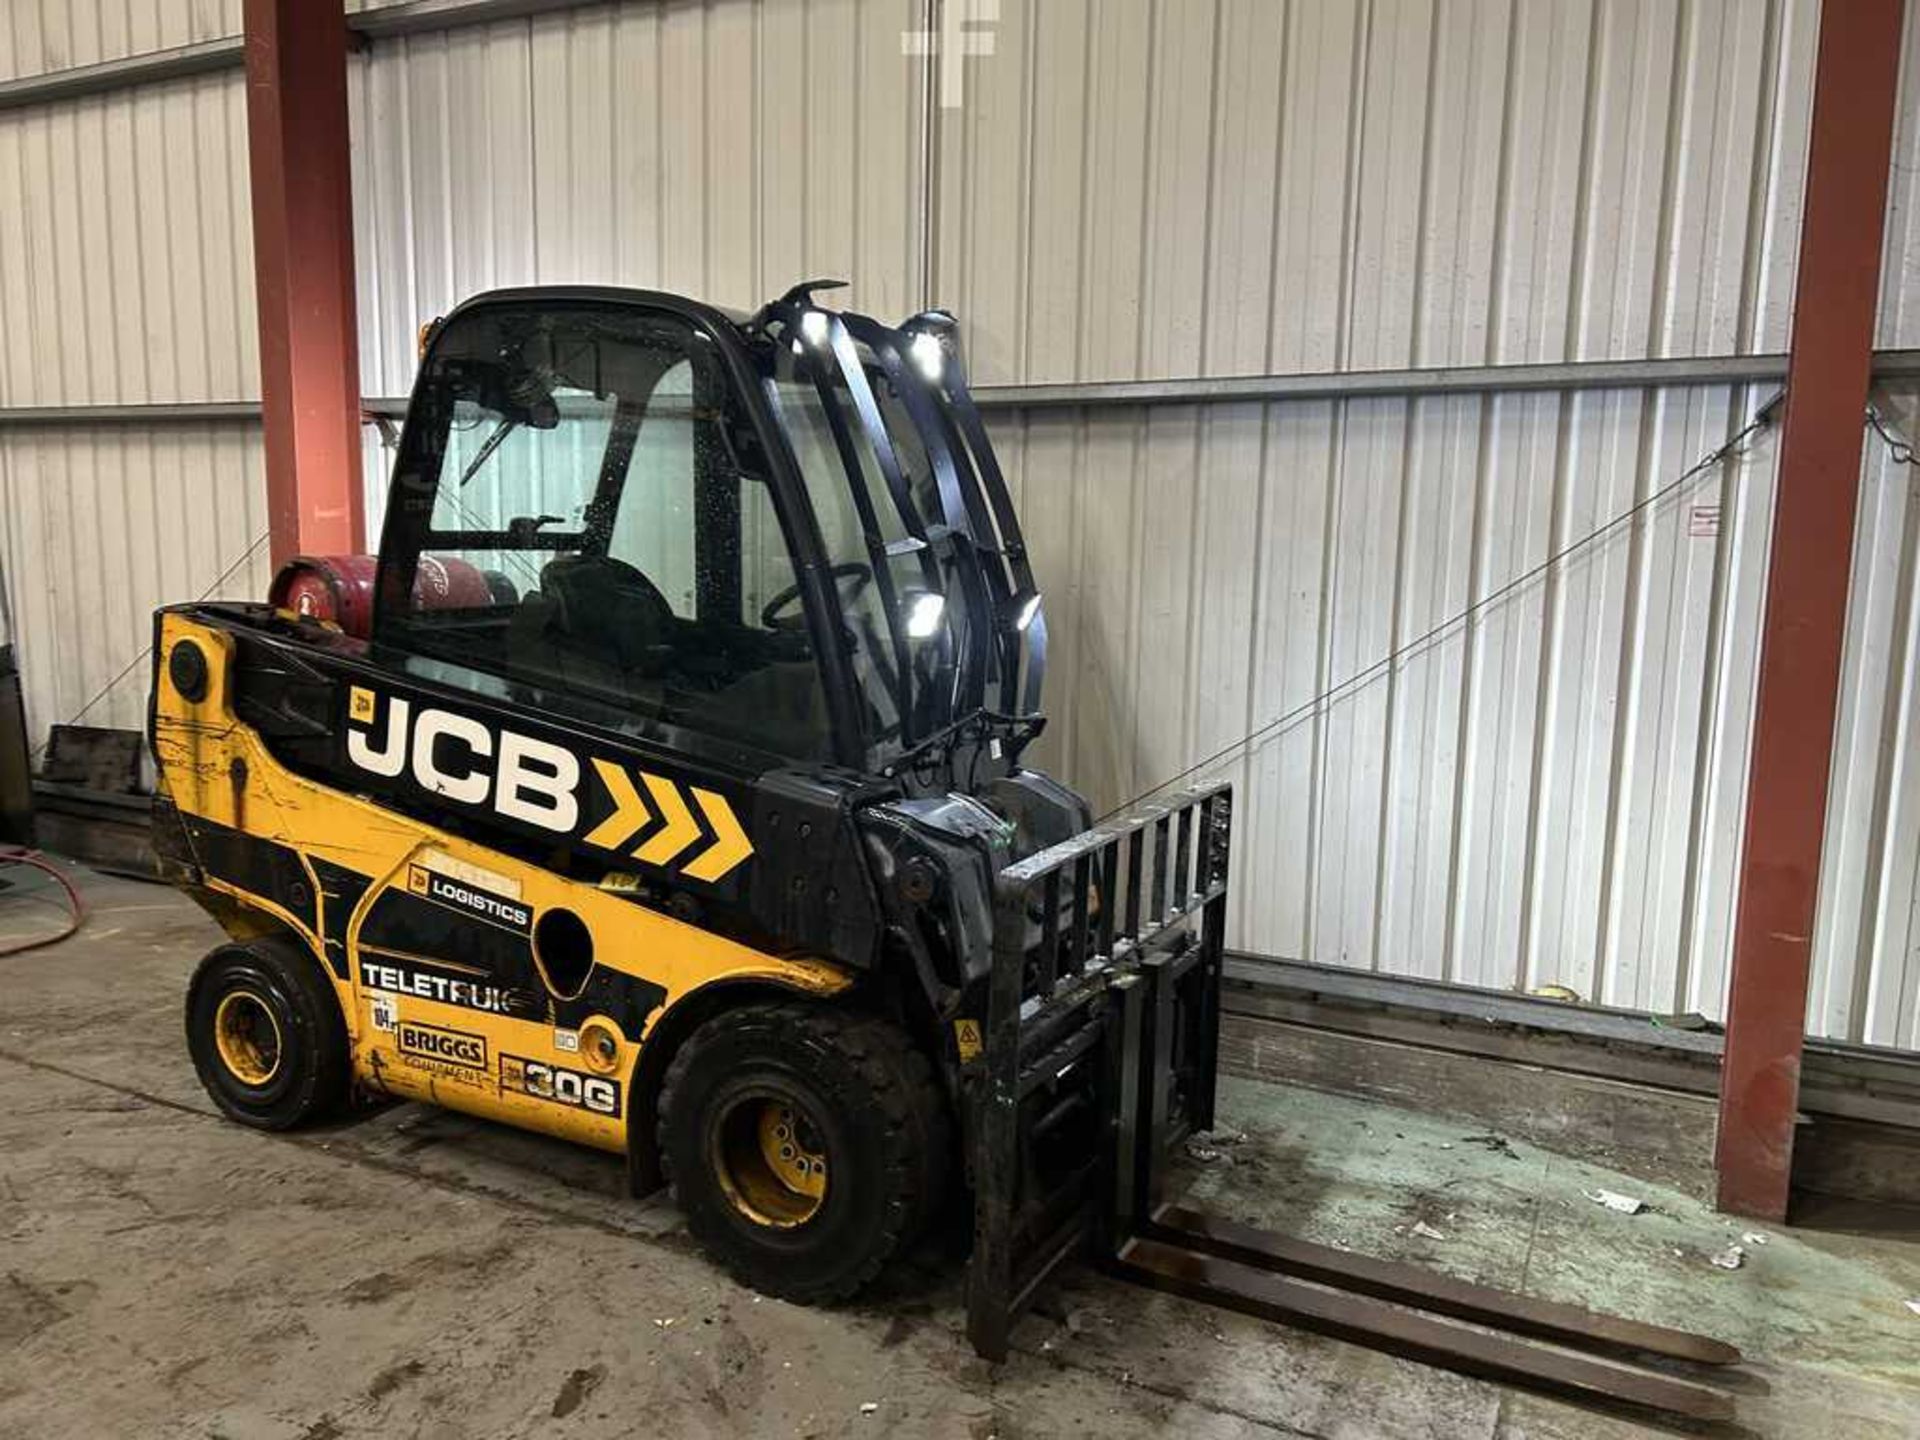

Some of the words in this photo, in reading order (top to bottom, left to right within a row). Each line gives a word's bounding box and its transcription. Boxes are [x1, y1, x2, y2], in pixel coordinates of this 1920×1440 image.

[347, 697, 580, 833] JCB
[432, 879, 529, 926] LOGISTICS
[403, 1028, 482, 1062] BRIGGS
[526, 1063, 615, 1113] 30G
